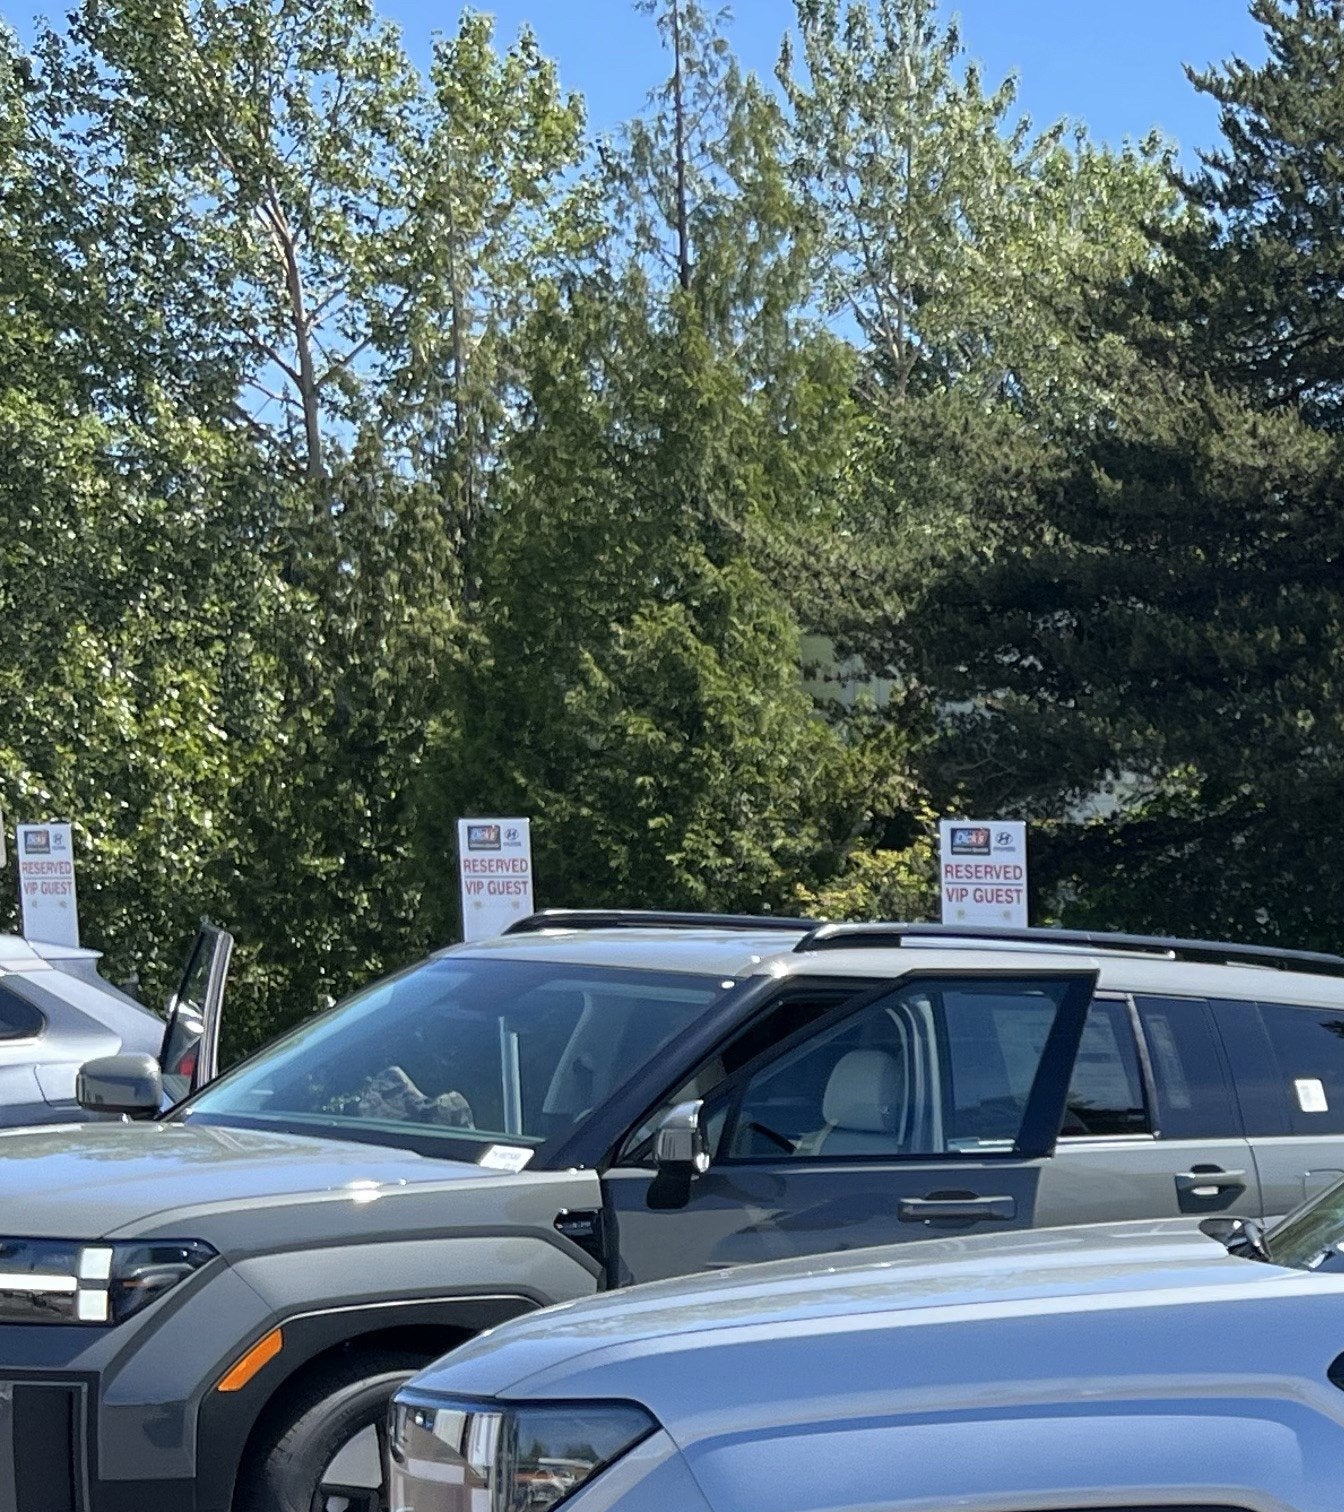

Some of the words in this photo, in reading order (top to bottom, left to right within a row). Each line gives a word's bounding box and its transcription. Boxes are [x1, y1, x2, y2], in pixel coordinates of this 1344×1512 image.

[21, 861, 72, 875] RESERVED
[463, 859, 529, 873] RESERVED
[944, 864, 1023, 881] RESERVED
[23, 881, 38, 895] VIP
[40, 881, 72, 895] GUEST
[464, 881, 484, 895] VIP
[487, 881, 528, 895] GUEST
[946, 888, 969, 902] VIP
[973, 888, 1023, 905] GUEST
